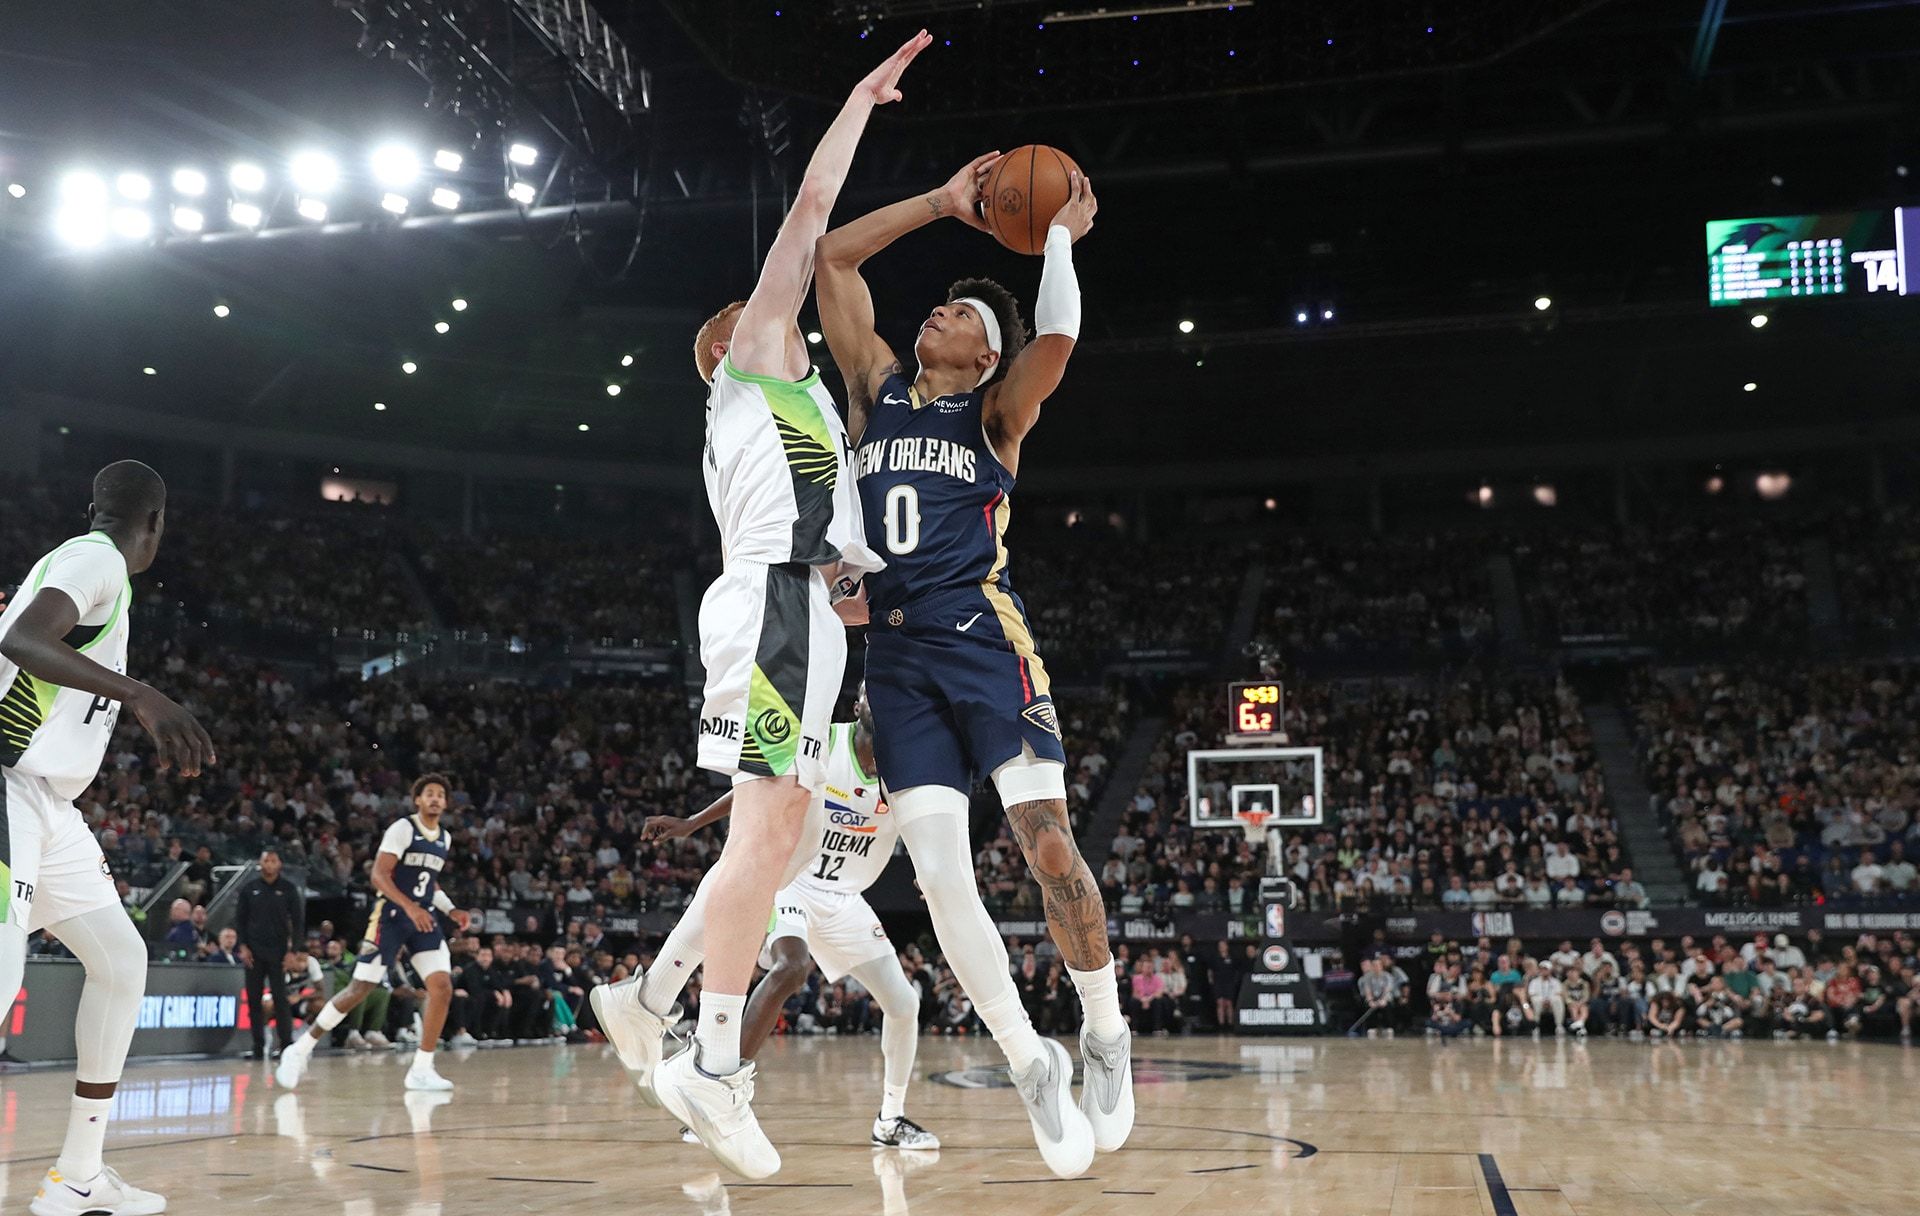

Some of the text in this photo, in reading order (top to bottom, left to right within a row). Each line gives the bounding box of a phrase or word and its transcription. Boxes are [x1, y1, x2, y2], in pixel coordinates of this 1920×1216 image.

[933, 400, 969, 409] NEWAGE
[889, 437, 976, 484] ORLEANS
[883, 484, 921, 555] 0
[1243, 686, 1279, 704] 4:53
[700, 716, 739, 741] ADIE
[1239, 702, 1272, 731] 6.2
[825, 785, 849, 799] STANLEY
[830, 811, 870, 826] GOAT
[813, 853, 846, 881] 12
[412, 871, 431, 898] 3
[1704, 911, 1801, 927] MELBOURNE
[163, 995, 196, 1029] GAME
[196, 995, 219, 1028] LIVE
[219, 995, 236, 1028] ON
